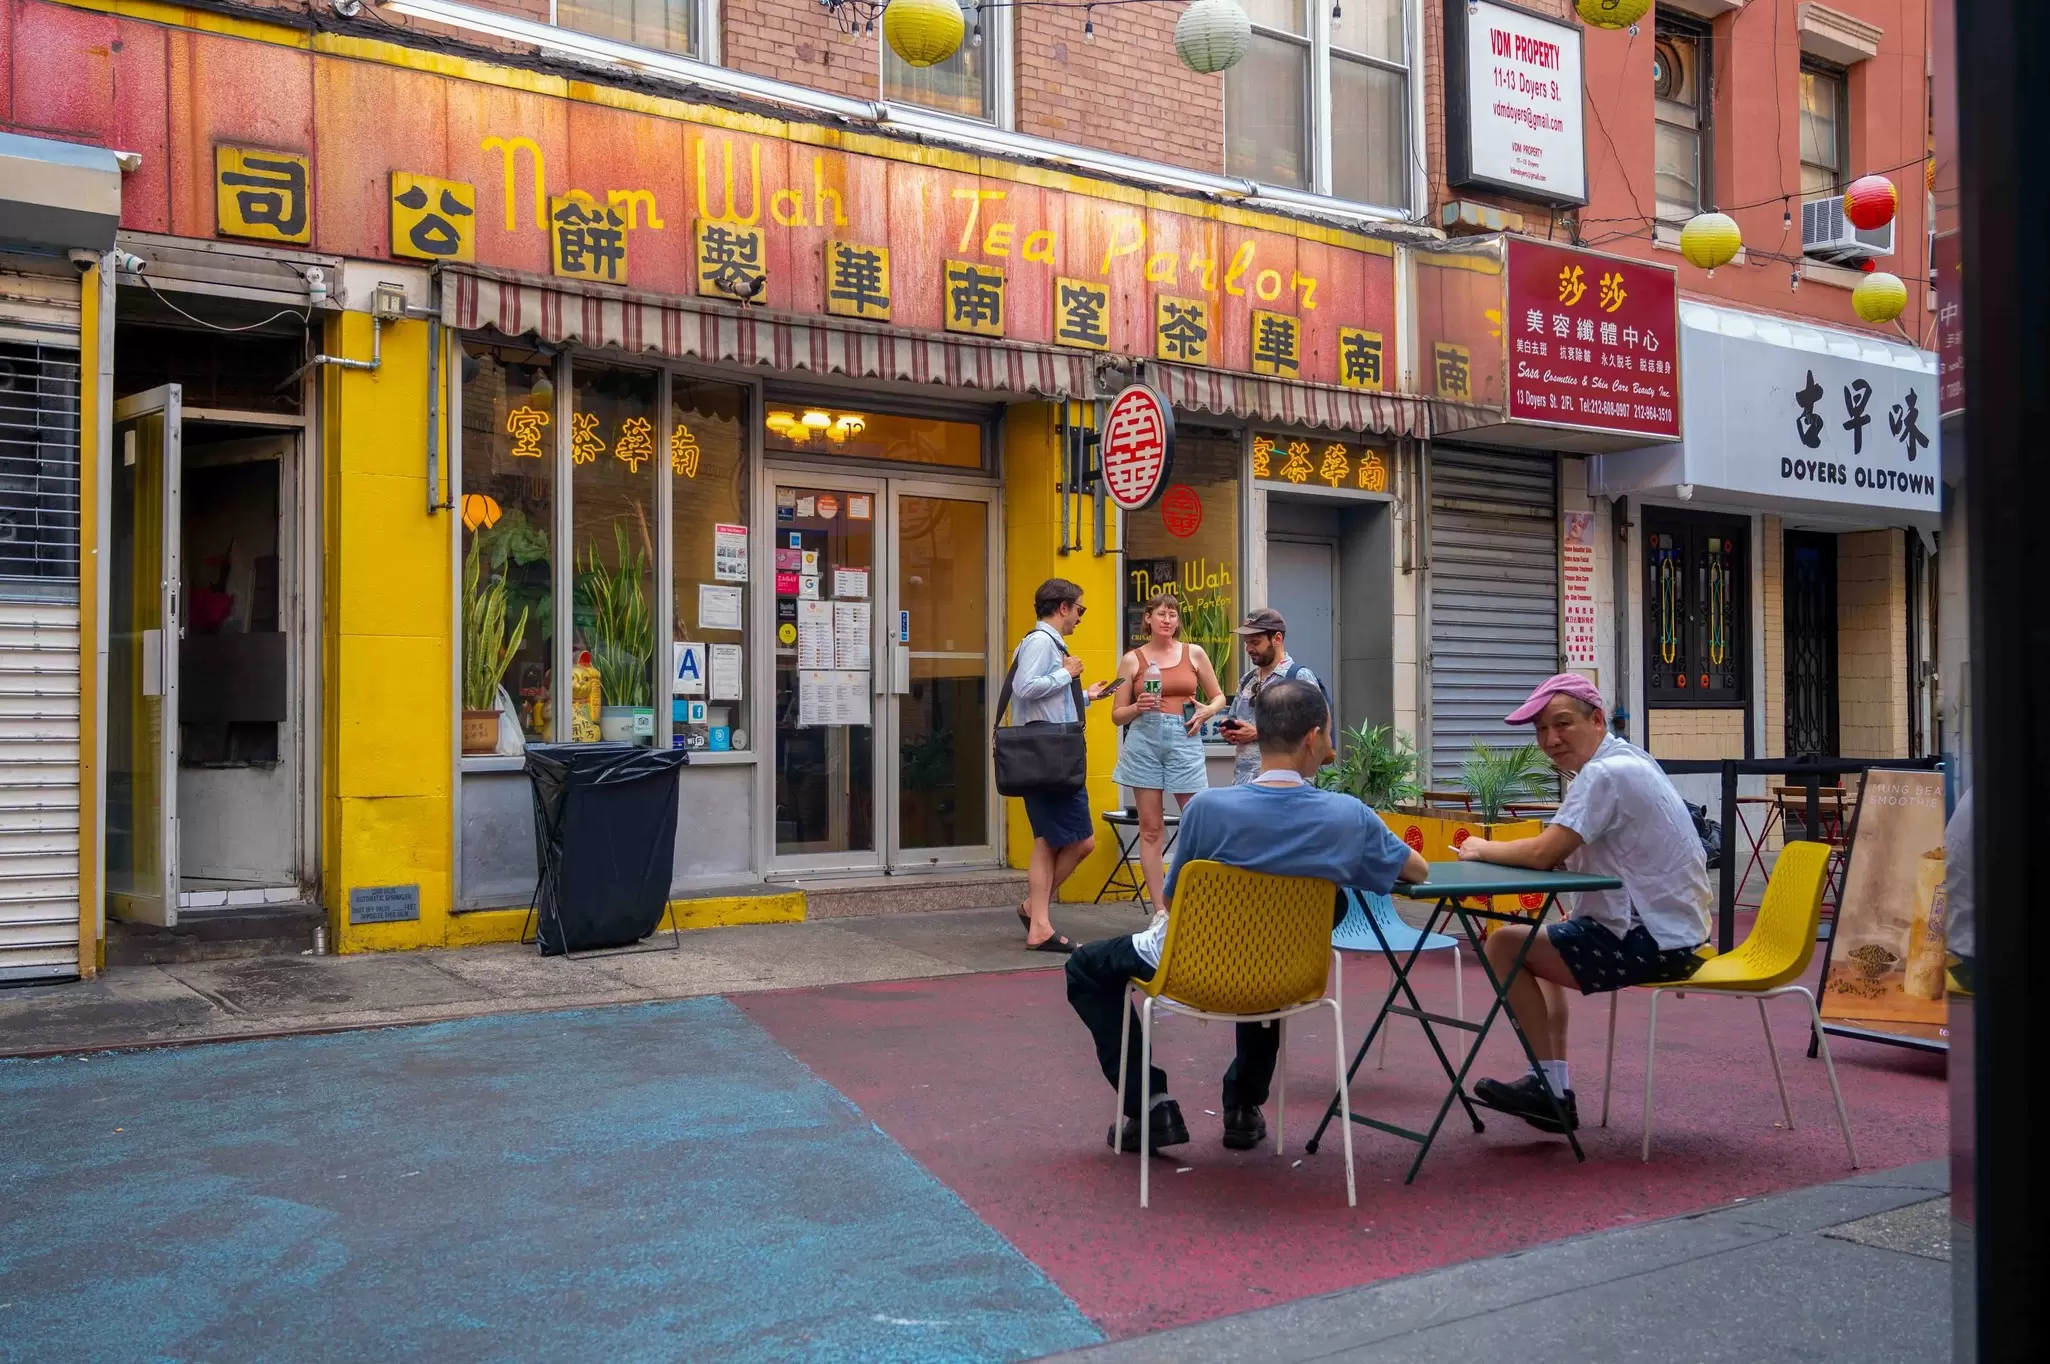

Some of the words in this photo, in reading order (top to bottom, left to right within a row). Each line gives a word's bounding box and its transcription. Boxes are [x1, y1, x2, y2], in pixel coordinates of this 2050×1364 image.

[1490, 28, 1512, 59] VDM
[1515, 34, 1560, 71] PROPERTY
[1494, 66, 1516, 90] 11-13
[1519, 72, 1547, 100] Doyers
[1550, 80, 1562, 102] St.
[1493, 100, 1563, 132] vdmdoyers@gmail.com
[1511, 142, 1522, 153] VDM
[1523, 144, 1543, 158] PROPERTY
[480, 135, 665, 232] Nm
[696, 138, 848, 227] Wah
[951, 189, 1057, 265] Tea
[1100, 213, 1318, 311] Parlor
[1559, 264, 1628, 313] 莎莎
[1516, 338, 1548, 357] 美白去斑
[1526, 307, 1660, 352] 美容纖體中心
[1517, 360, 1540, 379] Sasa
[1543, 369, 1578, 385] Cosmetics
[1581, 375, 1588, 386] &
[1591, 376, 1609, 389] Skin
[1612, 379, 1629, 392] Care
[1632, 382, 1655, 398] Beauty
[1658, 385, 1671, 398] Inc.
[1517, 389, 1525, 405] 13
[1525, 390, 1547, 410] Doyers
[1795, 369, 1930, 462] 古早味
[1780, 456, 1847, 486] DOYERS
[1854, 466, 1935, 496] OLDTOWN
[1130, 569, 1179, 603] Nom
[1184, 557, 1232, 592] Wah
[1178, 601, 1194, 613] Tea
[1196, 596, 1232, 609] Parlor
[678, 648, 700, 680] A
[1870, 795, 1938, 808] SMOOTHIE
[1872, 783, 1909, 796] MUNG
